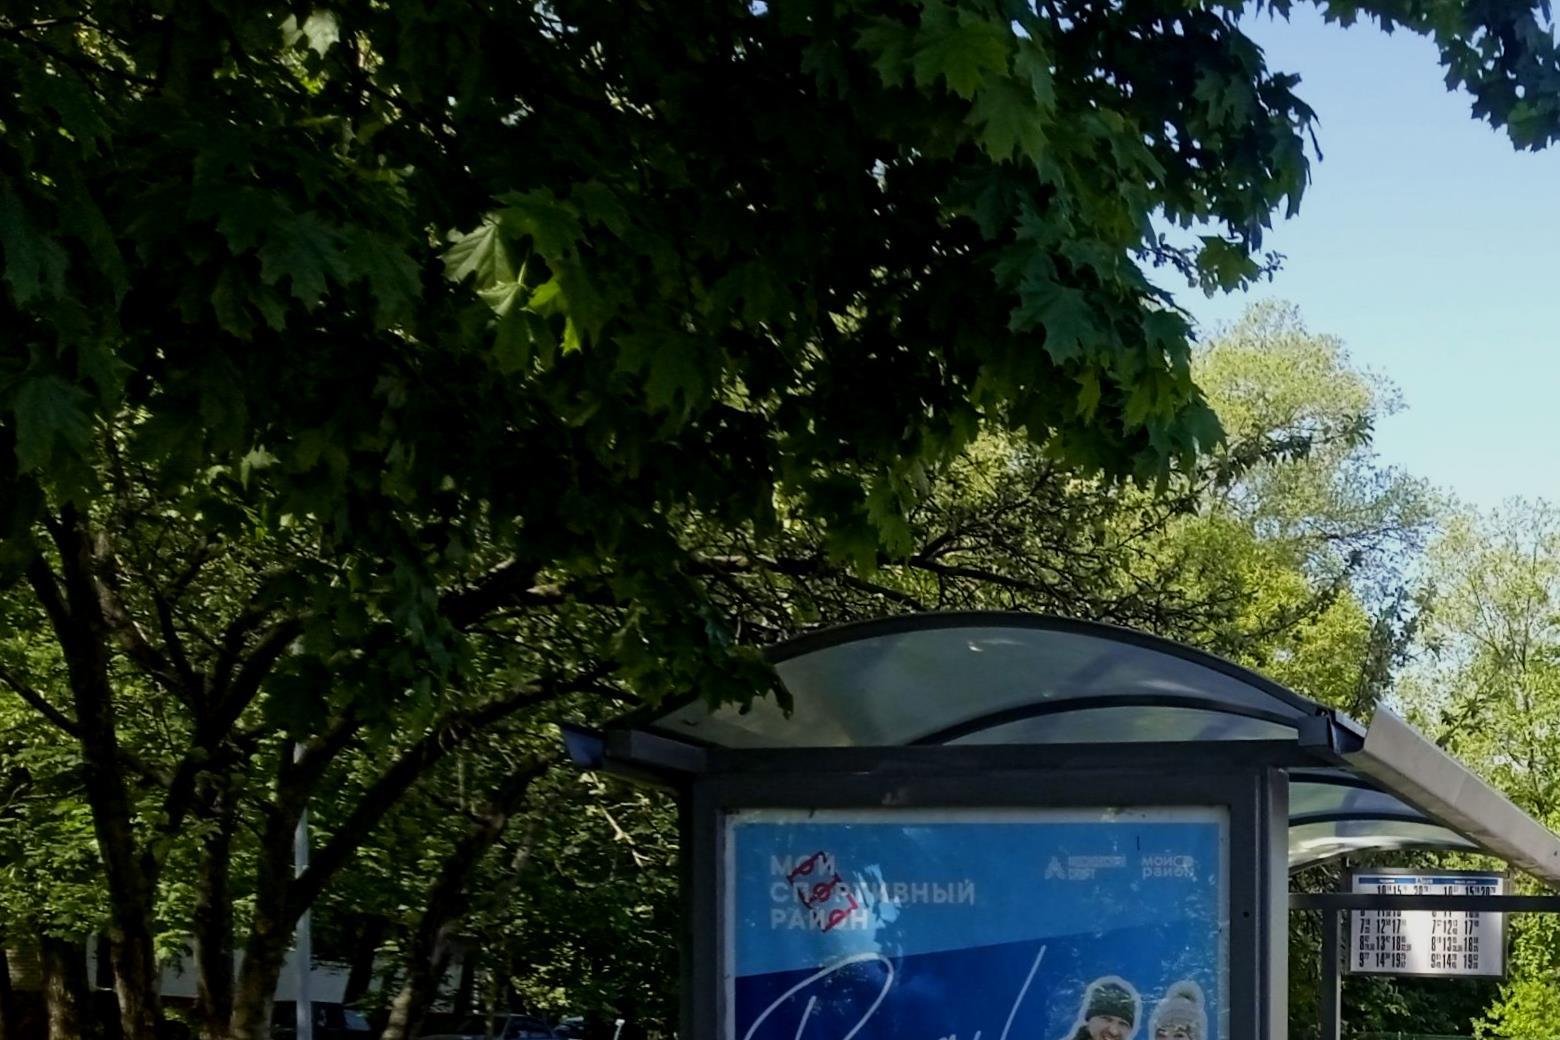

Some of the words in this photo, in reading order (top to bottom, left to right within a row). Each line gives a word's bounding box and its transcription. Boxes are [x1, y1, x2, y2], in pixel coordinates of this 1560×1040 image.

[770, 852, 835, 876] МОЙ
[770, 905, 868, 930] РАЙОН
[1376, 919, 1386, 934] 12
[1392, 919, 1401, 934] 17
[1443, 920, 1453, 935] 12
[1464, 920, 1473, 935] 17
[1376, 952, 1385, 968] 14
[1443, 953, 1451, 969] 14
